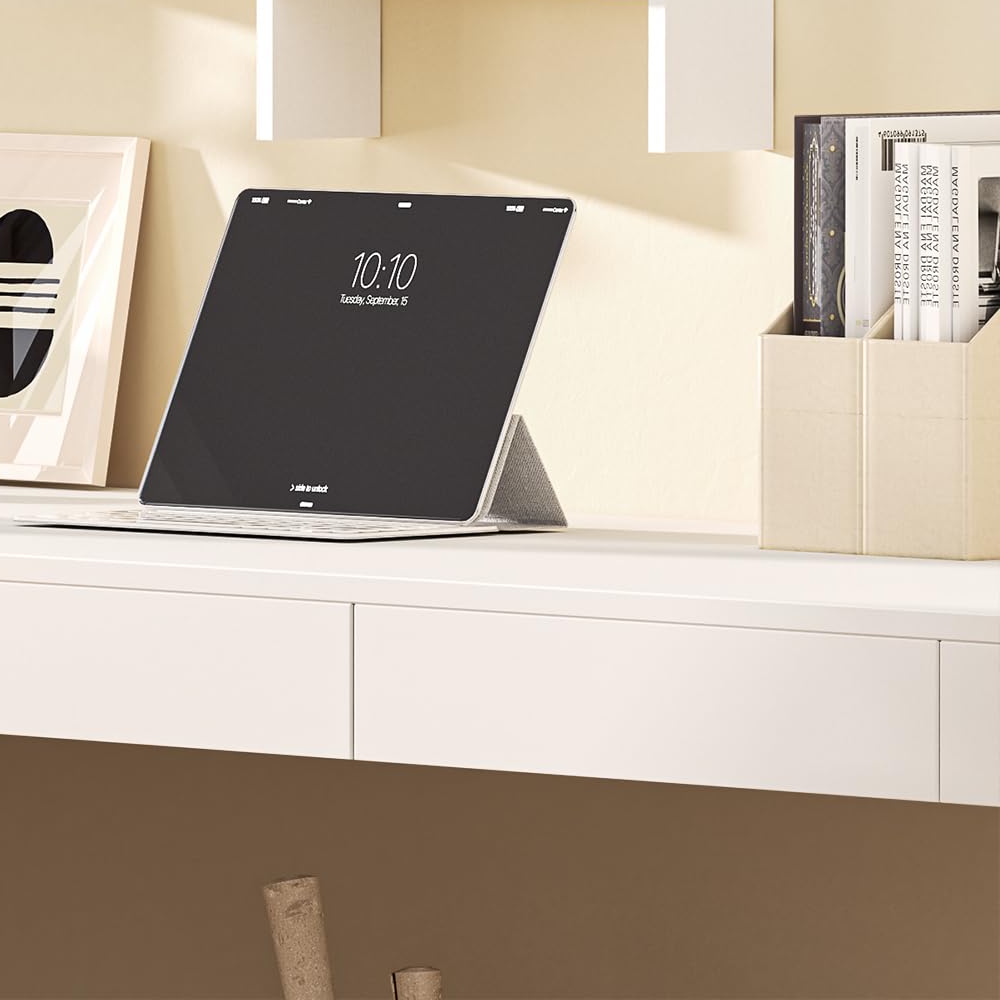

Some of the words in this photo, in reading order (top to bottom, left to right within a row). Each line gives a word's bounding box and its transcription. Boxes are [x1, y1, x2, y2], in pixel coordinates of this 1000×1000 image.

[351, 252, 418, 290] 10:10
[339, 293, 366, 307] Tuesday,
[365, 294, 400, 307] September,
[400, 296, 409, 307] 15
